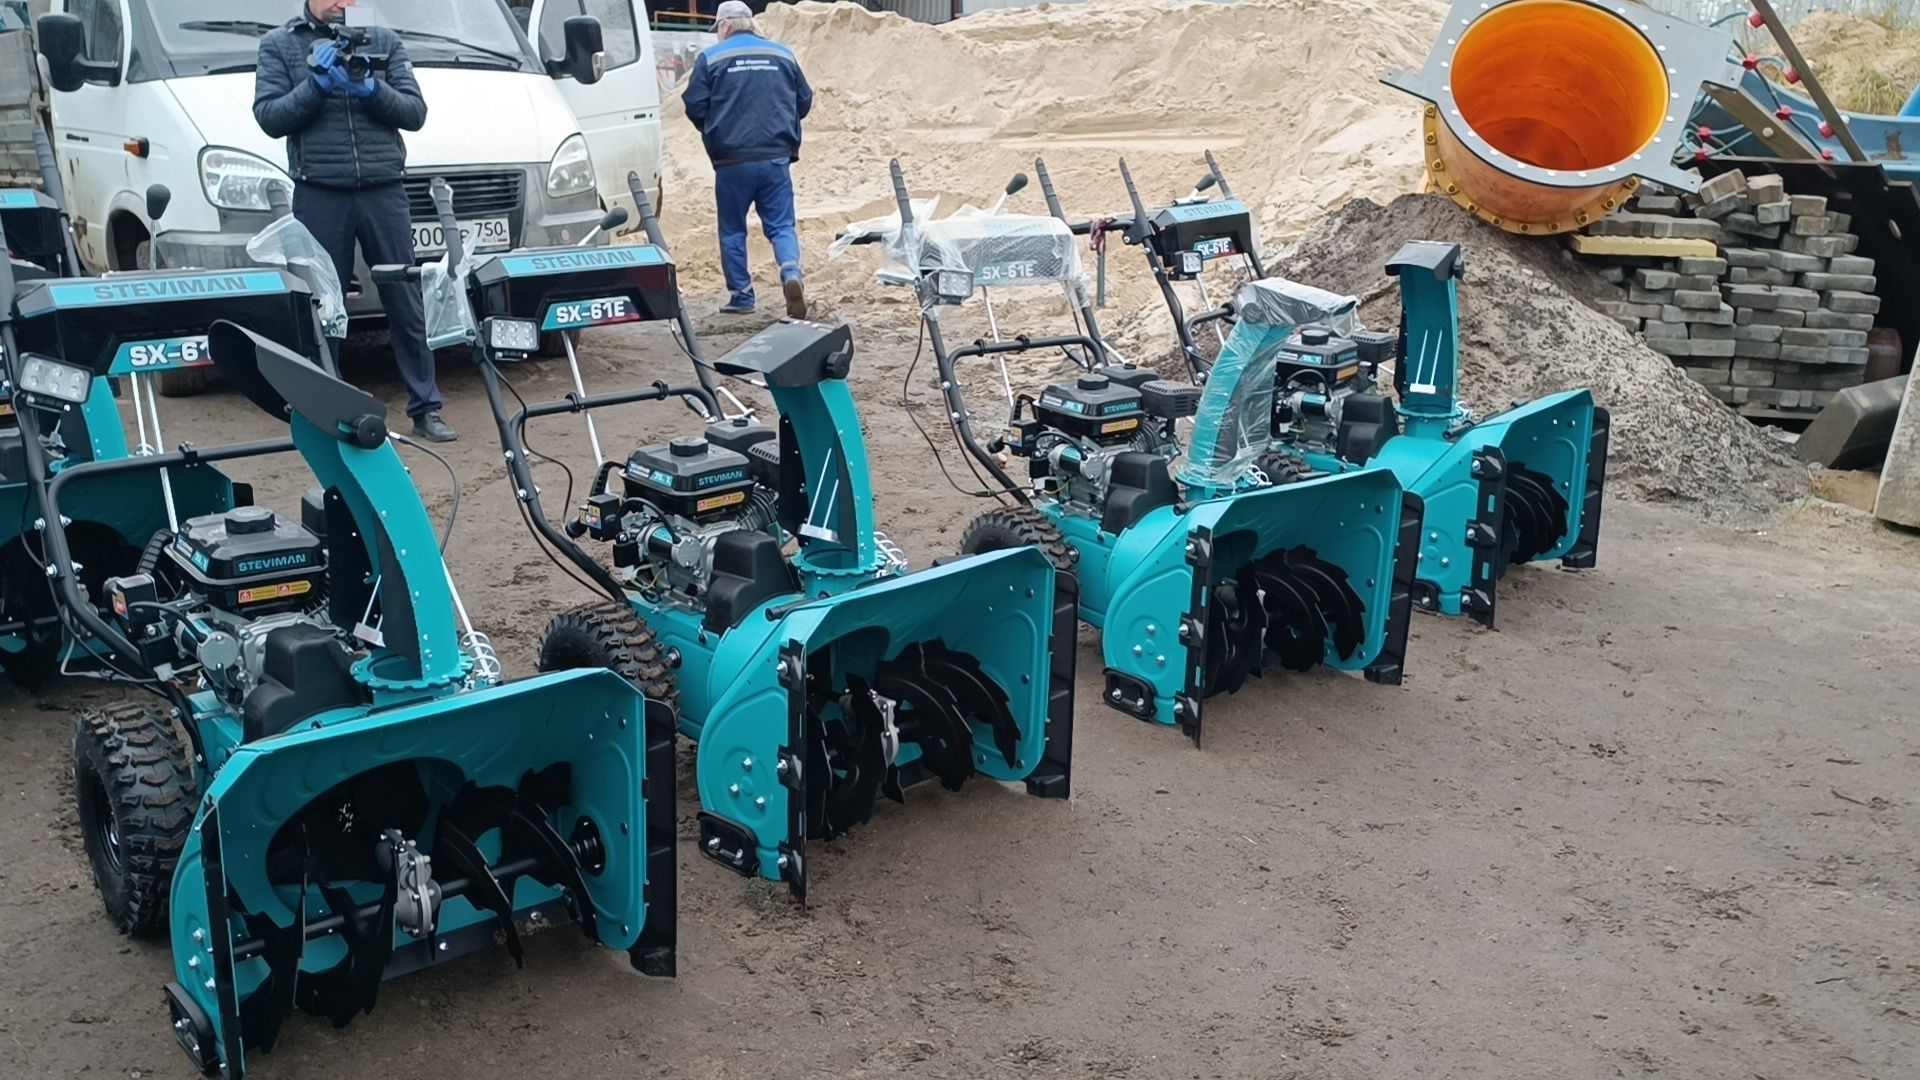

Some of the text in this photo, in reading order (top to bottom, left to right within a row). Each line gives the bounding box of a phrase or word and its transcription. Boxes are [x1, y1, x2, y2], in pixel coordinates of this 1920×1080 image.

[531, 250, 636, 271] STEVIMAN
[982, 263, 1034, 280] SX-61E
[93, 276, 248, 300] STEVIMAN
[556, 300, 626, 324] SX-61E
[698, 470, 743, 486] STEVIMAN
[238, 553, 306, 572] STEVIMAN
